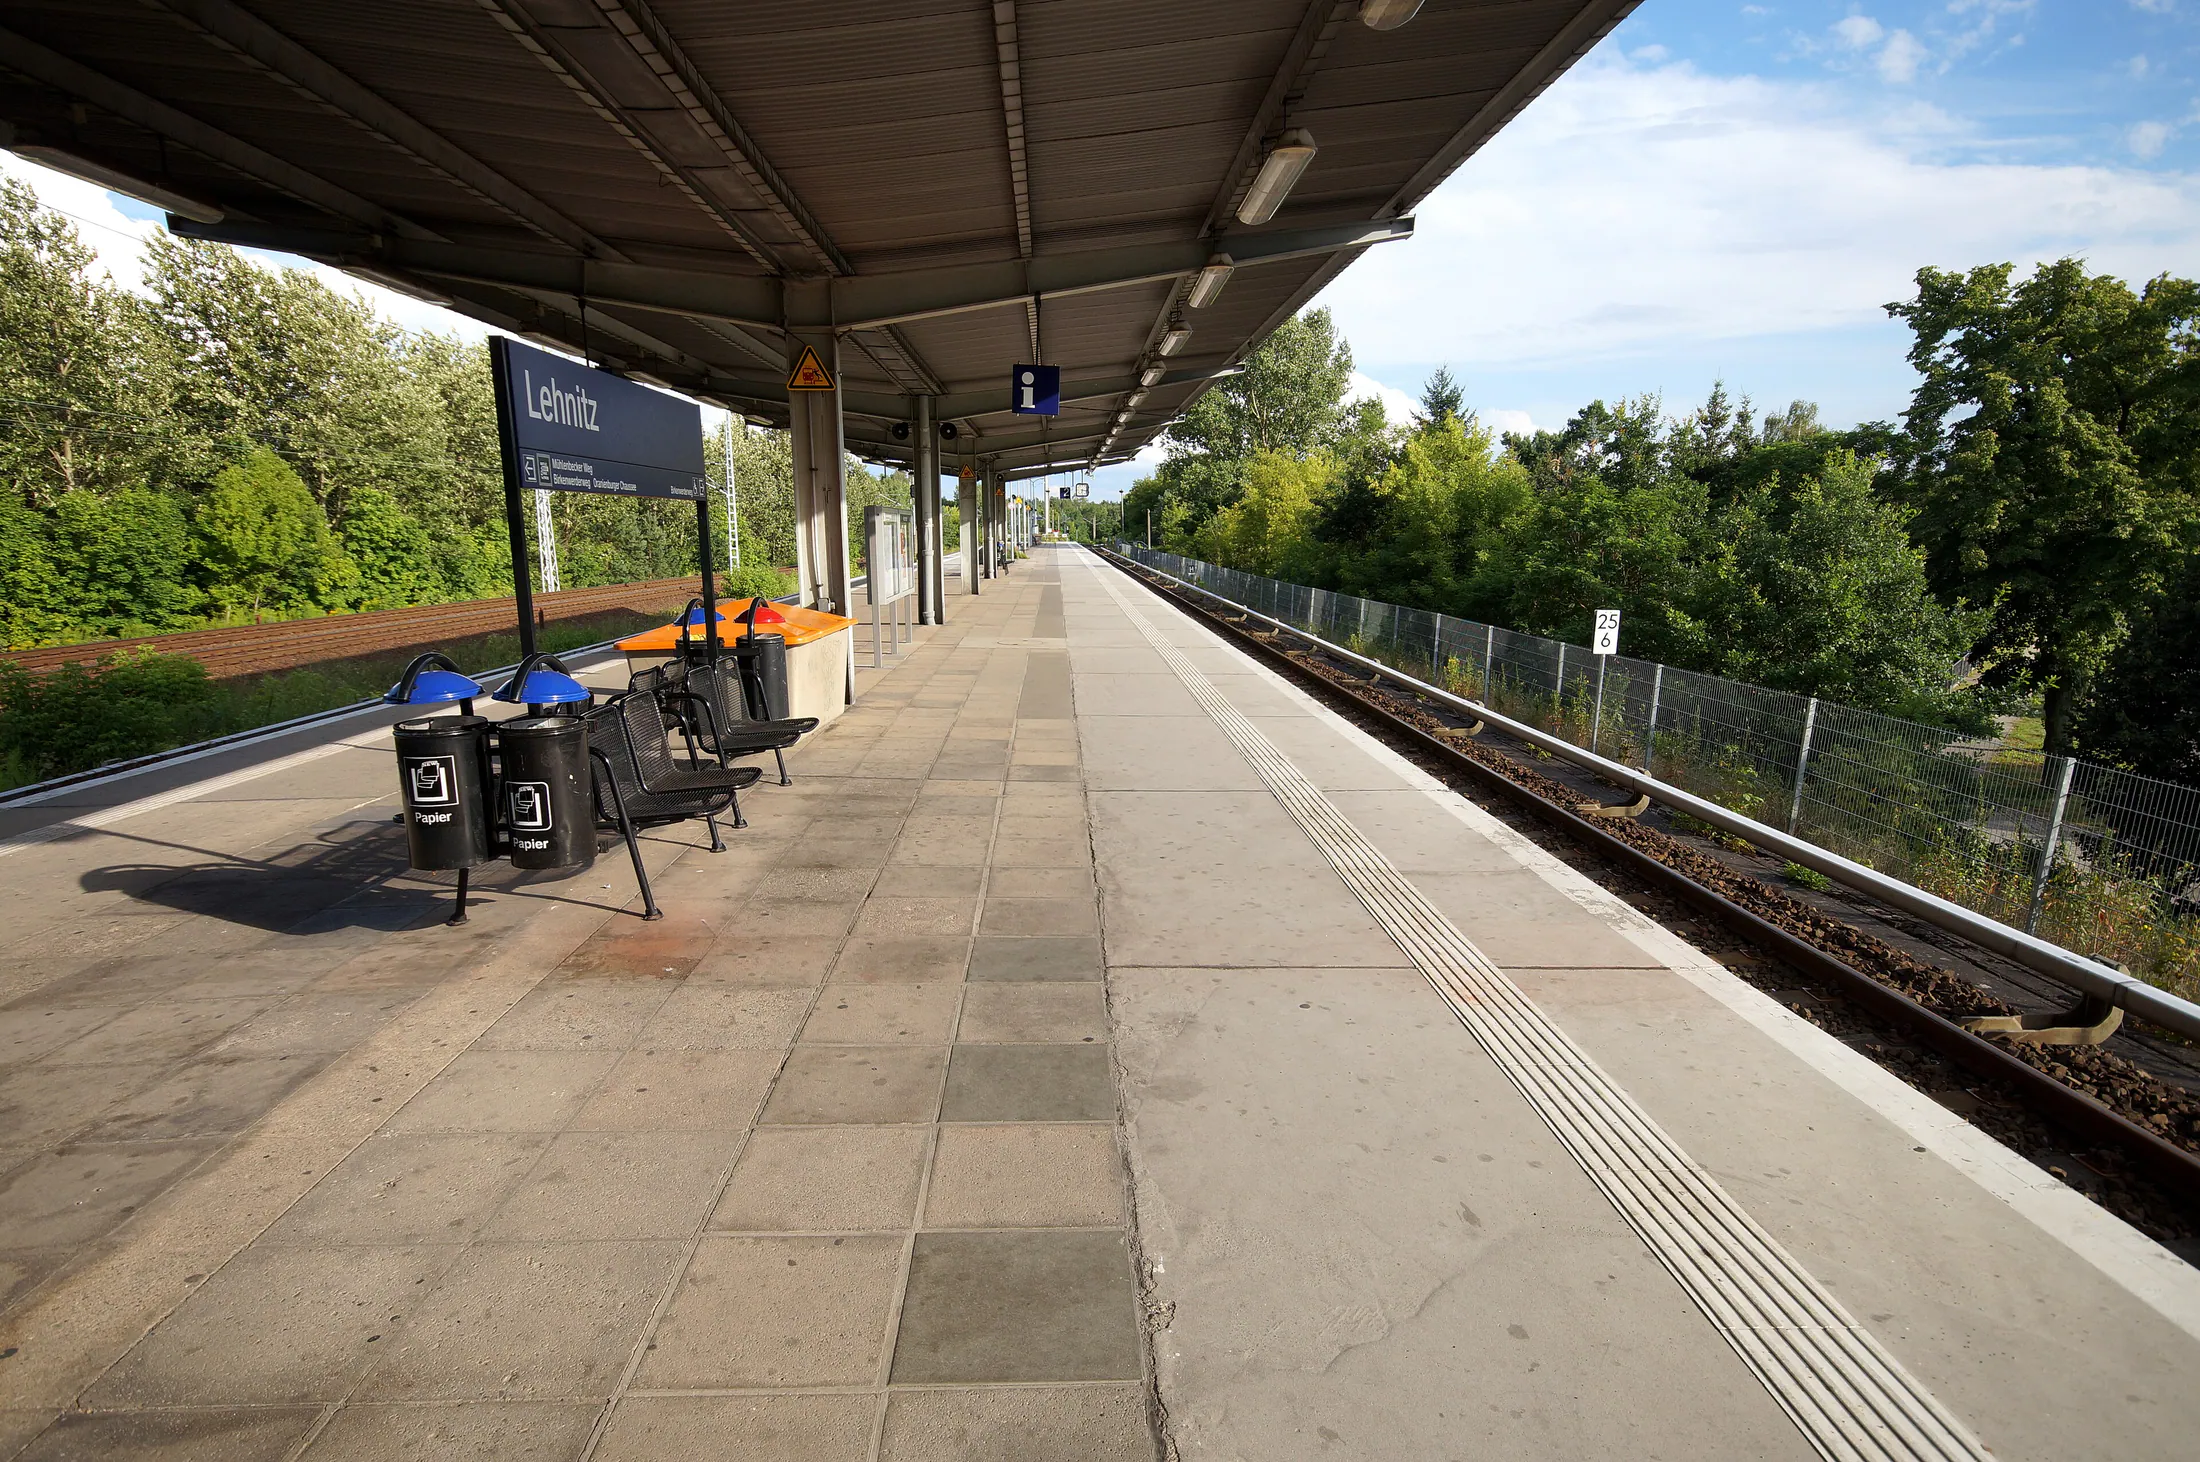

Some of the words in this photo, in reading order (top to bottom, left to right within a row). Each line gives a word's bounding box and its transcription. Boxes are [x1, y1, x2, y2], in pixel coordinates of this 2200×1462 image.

[525, 369, 600, 432] Lehnitz
[552, 458, 584, 472] Mühlenbecker
[583, 462, 593, 476] Weg
[1063, 487, 1069, 497] 2
[1598, 614, 1618, 629] 25
[1601, 632, 1611, 647] 6
[415, 812, 452, 825] Papier
[513, 837, 549, 851] Papier
